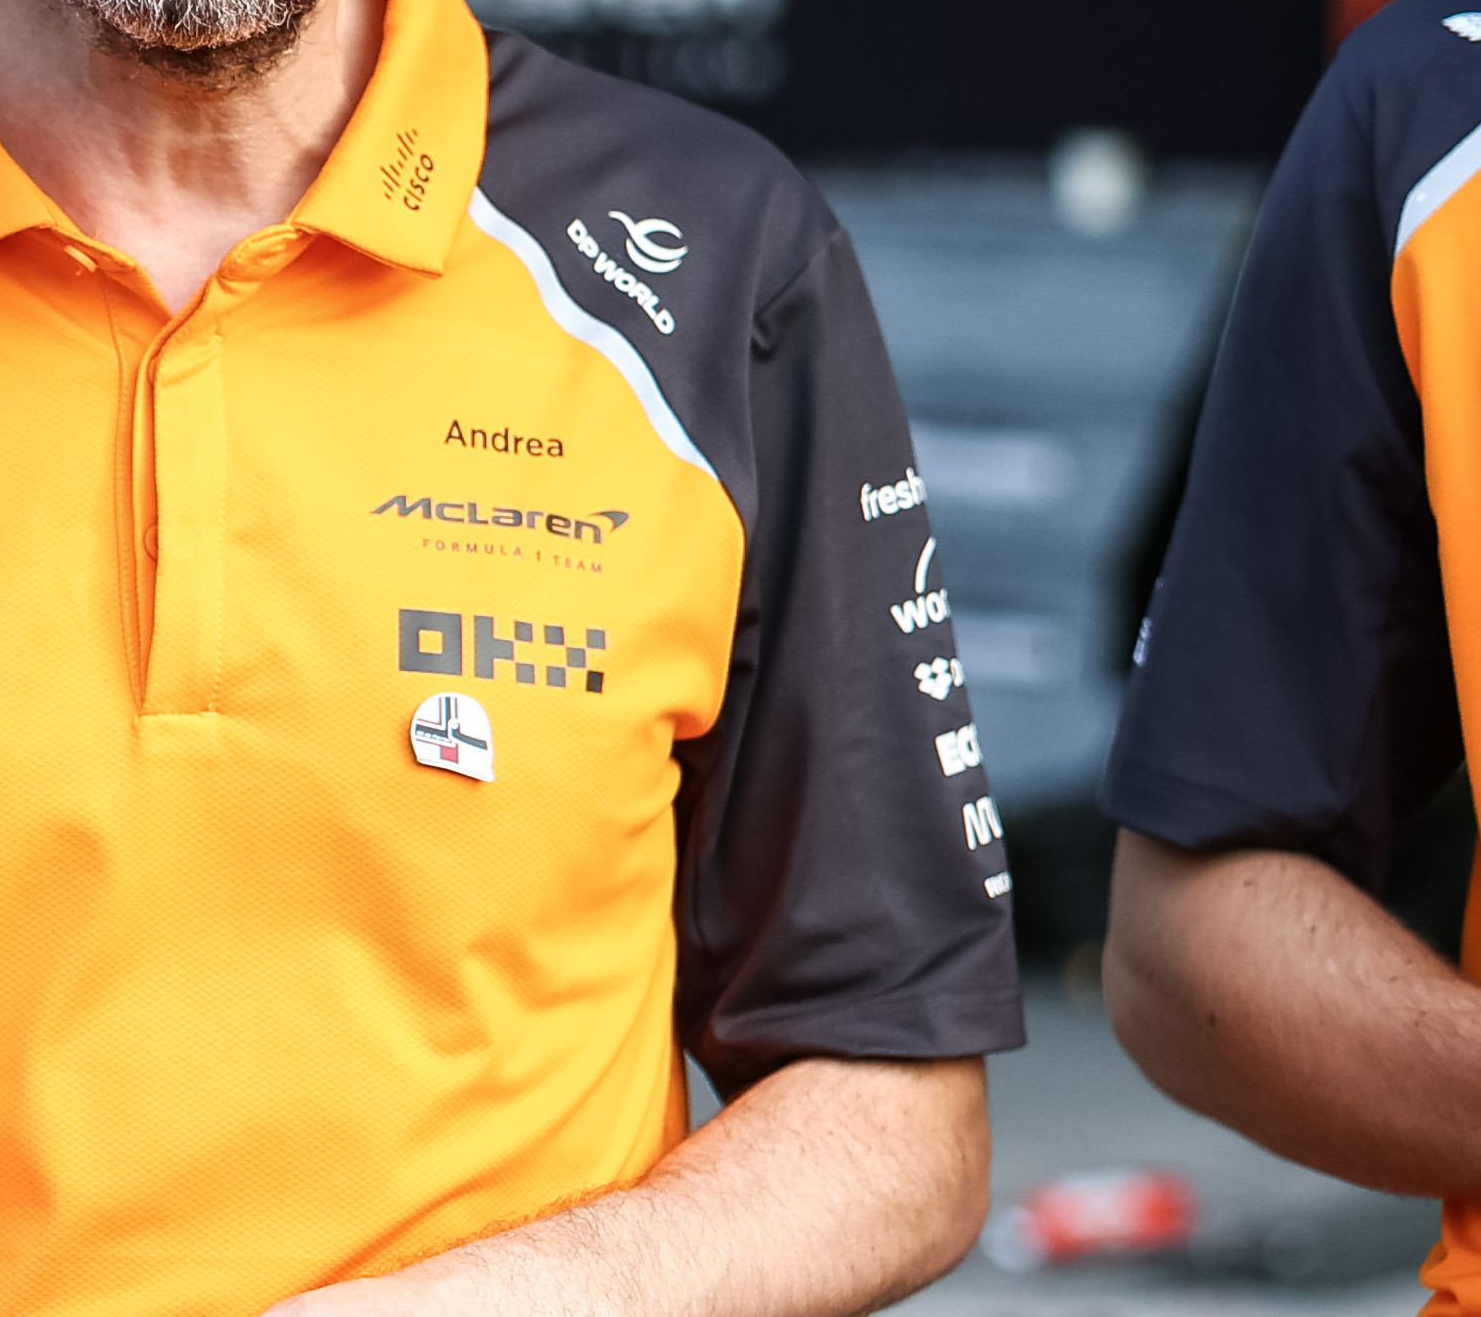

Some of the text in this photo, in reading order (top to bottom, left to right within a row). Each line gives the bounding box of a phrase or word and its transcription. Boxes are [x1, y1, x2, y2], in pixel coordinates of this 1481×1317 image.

[567, 219, 676, 335] DP WORLD
[444, 419, 564, 458] Andrea
[370, 494, 602, 544] McLaren
[422, 539, 523, 558] FORMULA
[553, 556, 603, 573] TEAM
